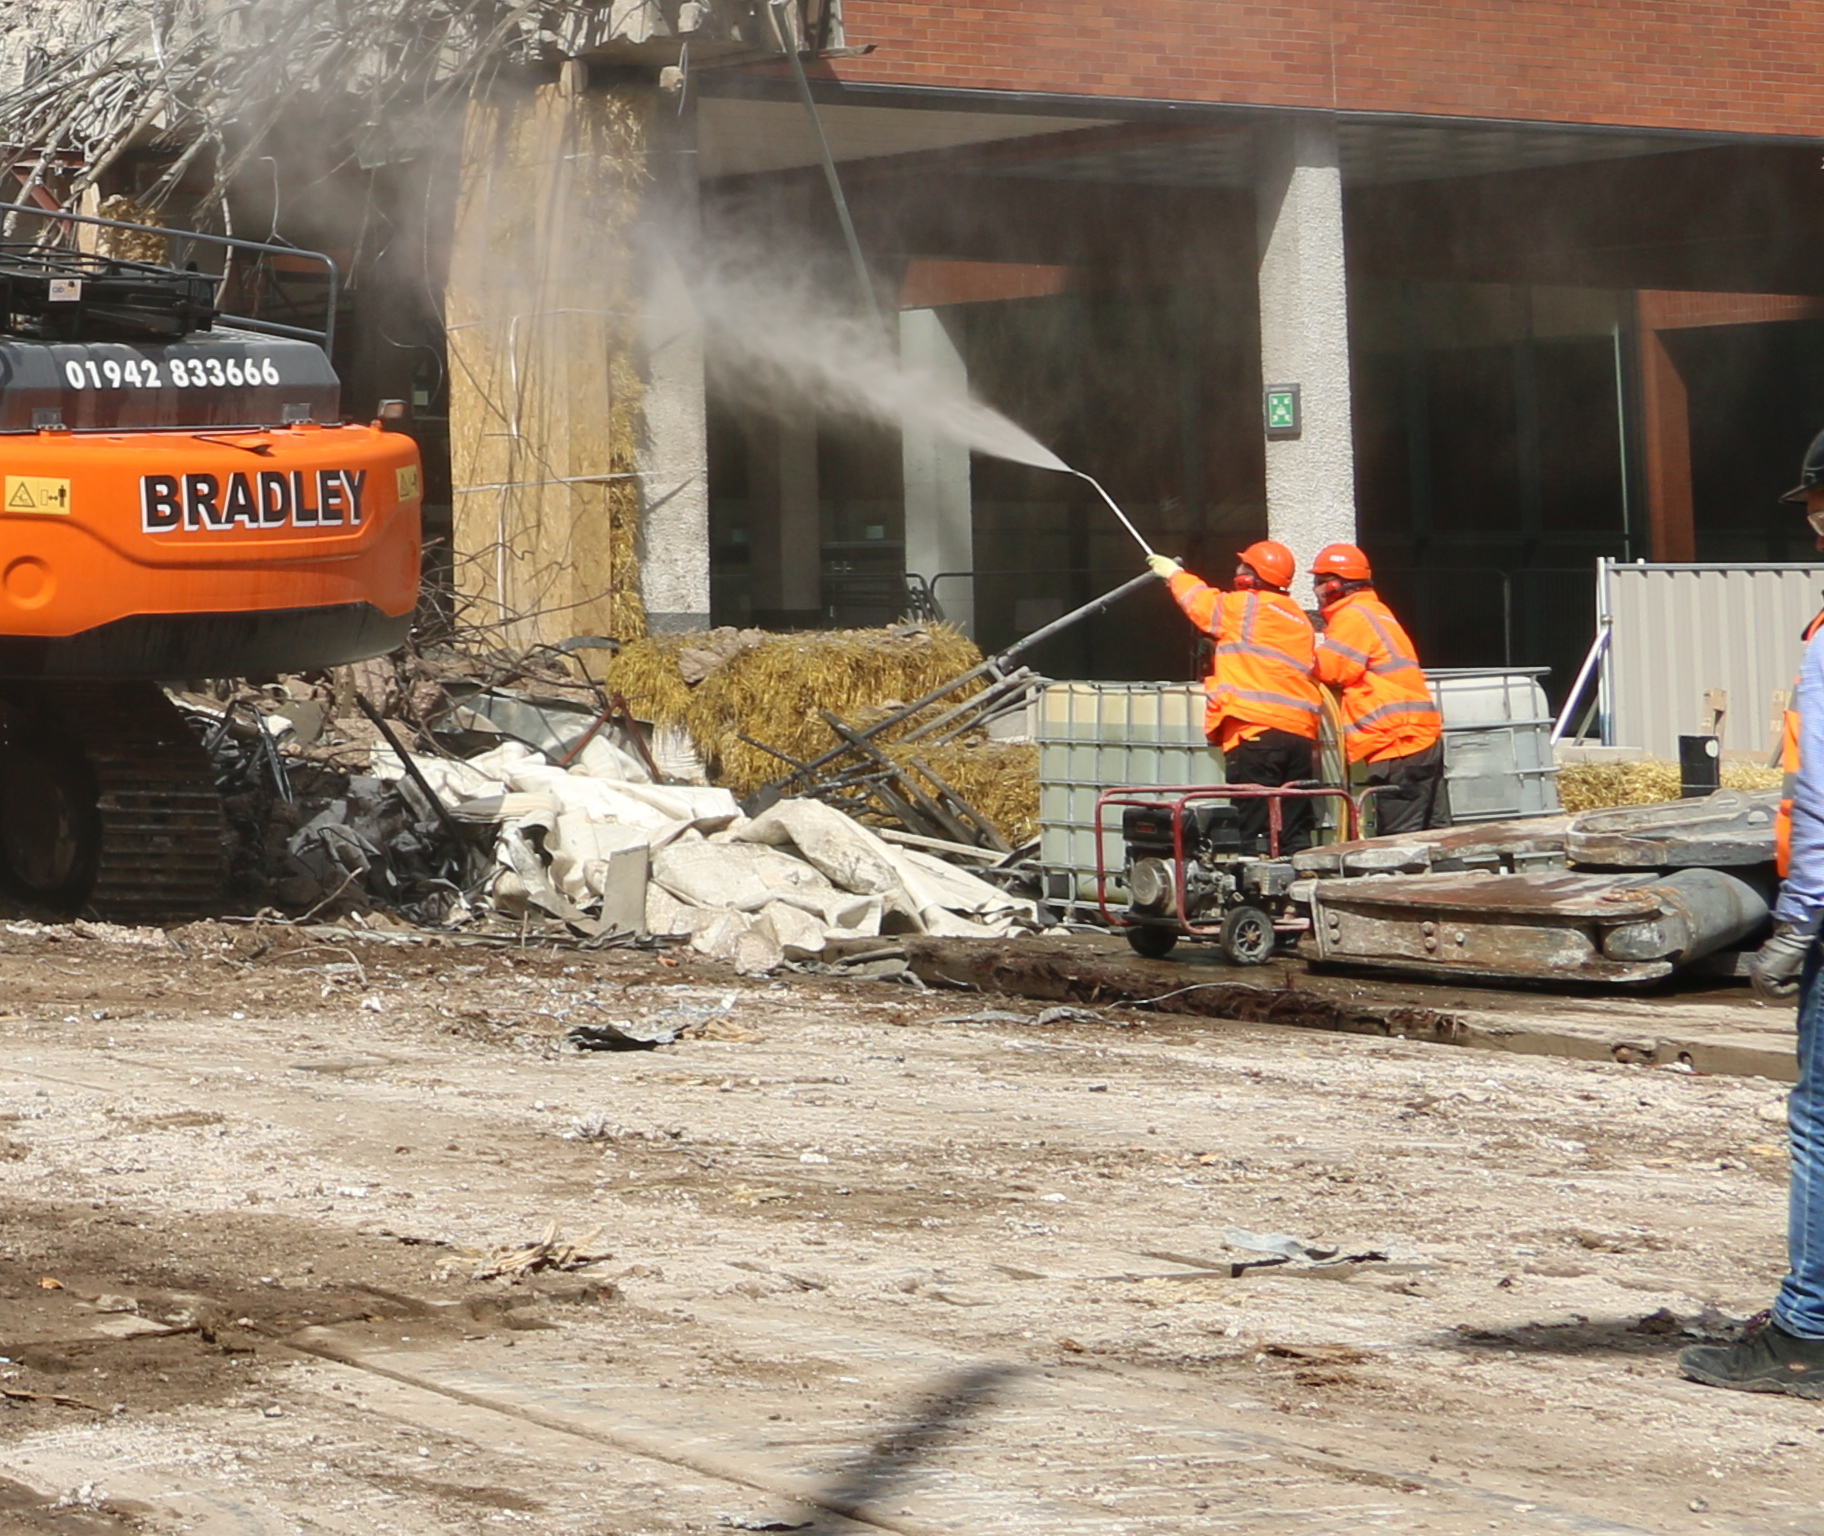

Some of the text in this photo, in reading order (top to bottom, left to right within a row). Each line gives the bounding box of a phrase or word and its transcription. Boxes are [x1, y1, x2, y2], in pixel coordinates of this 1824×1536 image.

[65, 357, 281, 390] 01942 833666
[139, 469, 367, 533] BRADLEY
